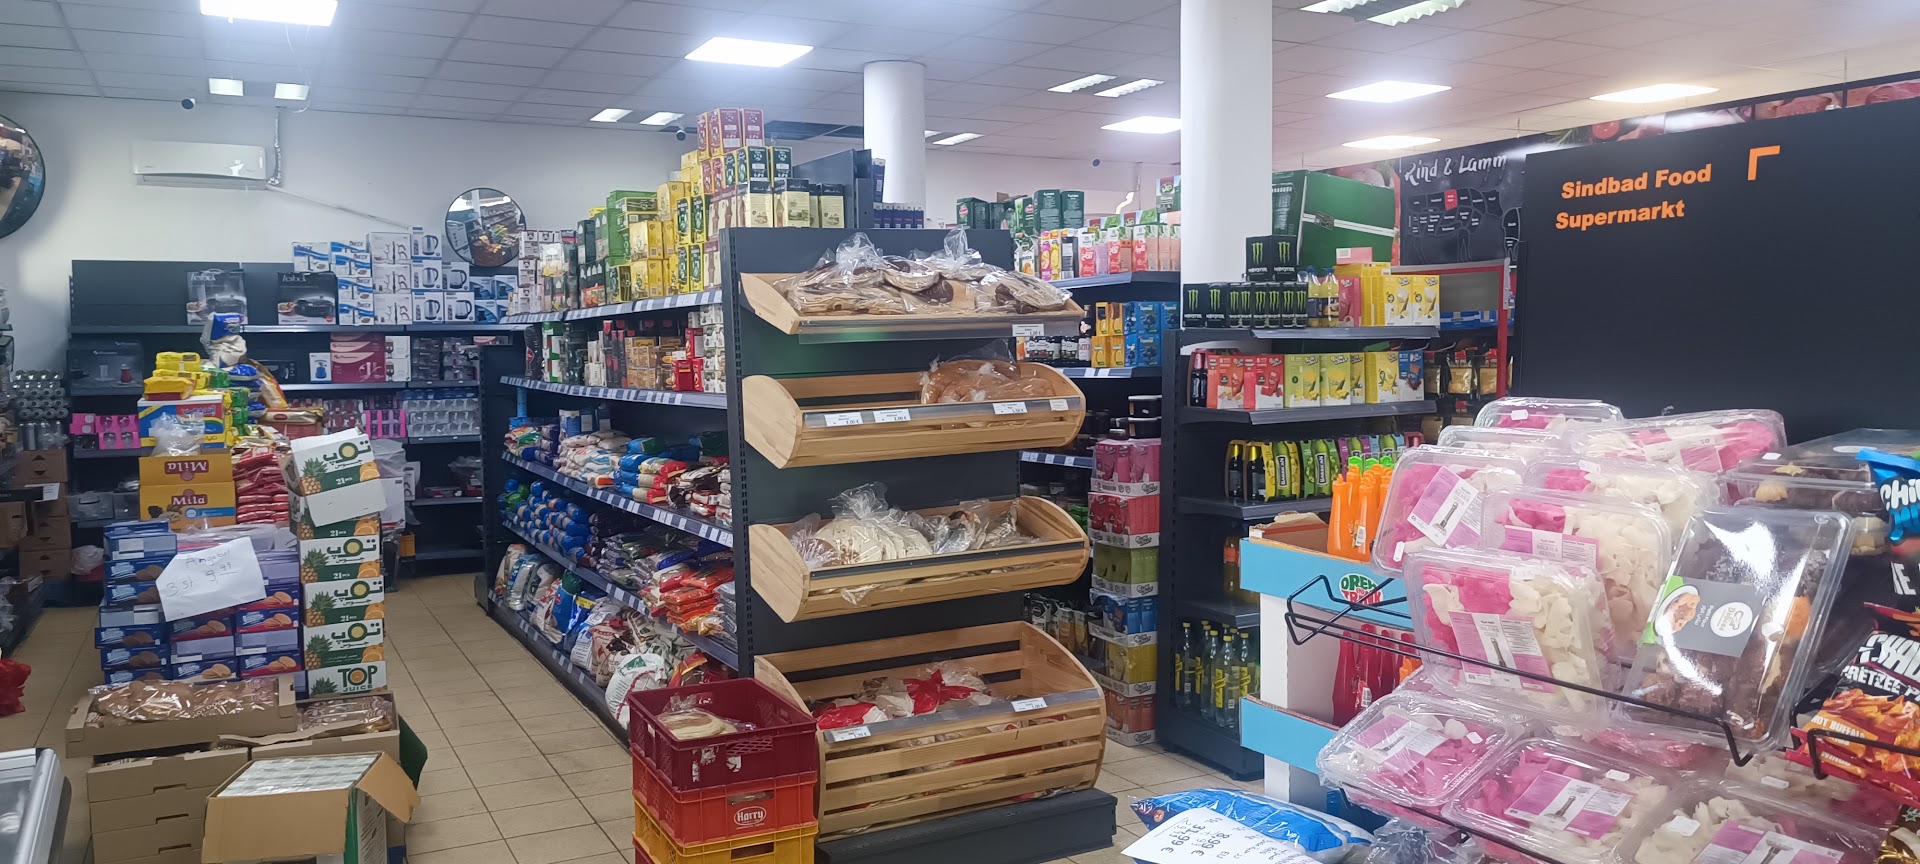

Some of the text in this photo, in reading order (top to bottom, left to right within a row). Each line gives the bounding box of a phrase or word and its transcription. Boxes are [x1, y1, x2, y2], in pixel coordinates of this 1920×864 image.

[1404, 158, 1438, 187] Rind
[1458, 155, 1508, 177] Lamm
[1561, 163, 1712, 200] Sindbad Food
[1555, 199, 1685, 231] Supermarkt
[167, 461, 208, 473] Mila
[335, 477, 345, 485] 21
[171, 495, 206, 506] Mila
[166, 582, 178, 597] 3
[340, 614, 349, 622] 21
[337, 665, 378, 688] TOP
[343, 684, 373, 692] JUICE
[737, 811, 764, 823] Harry
